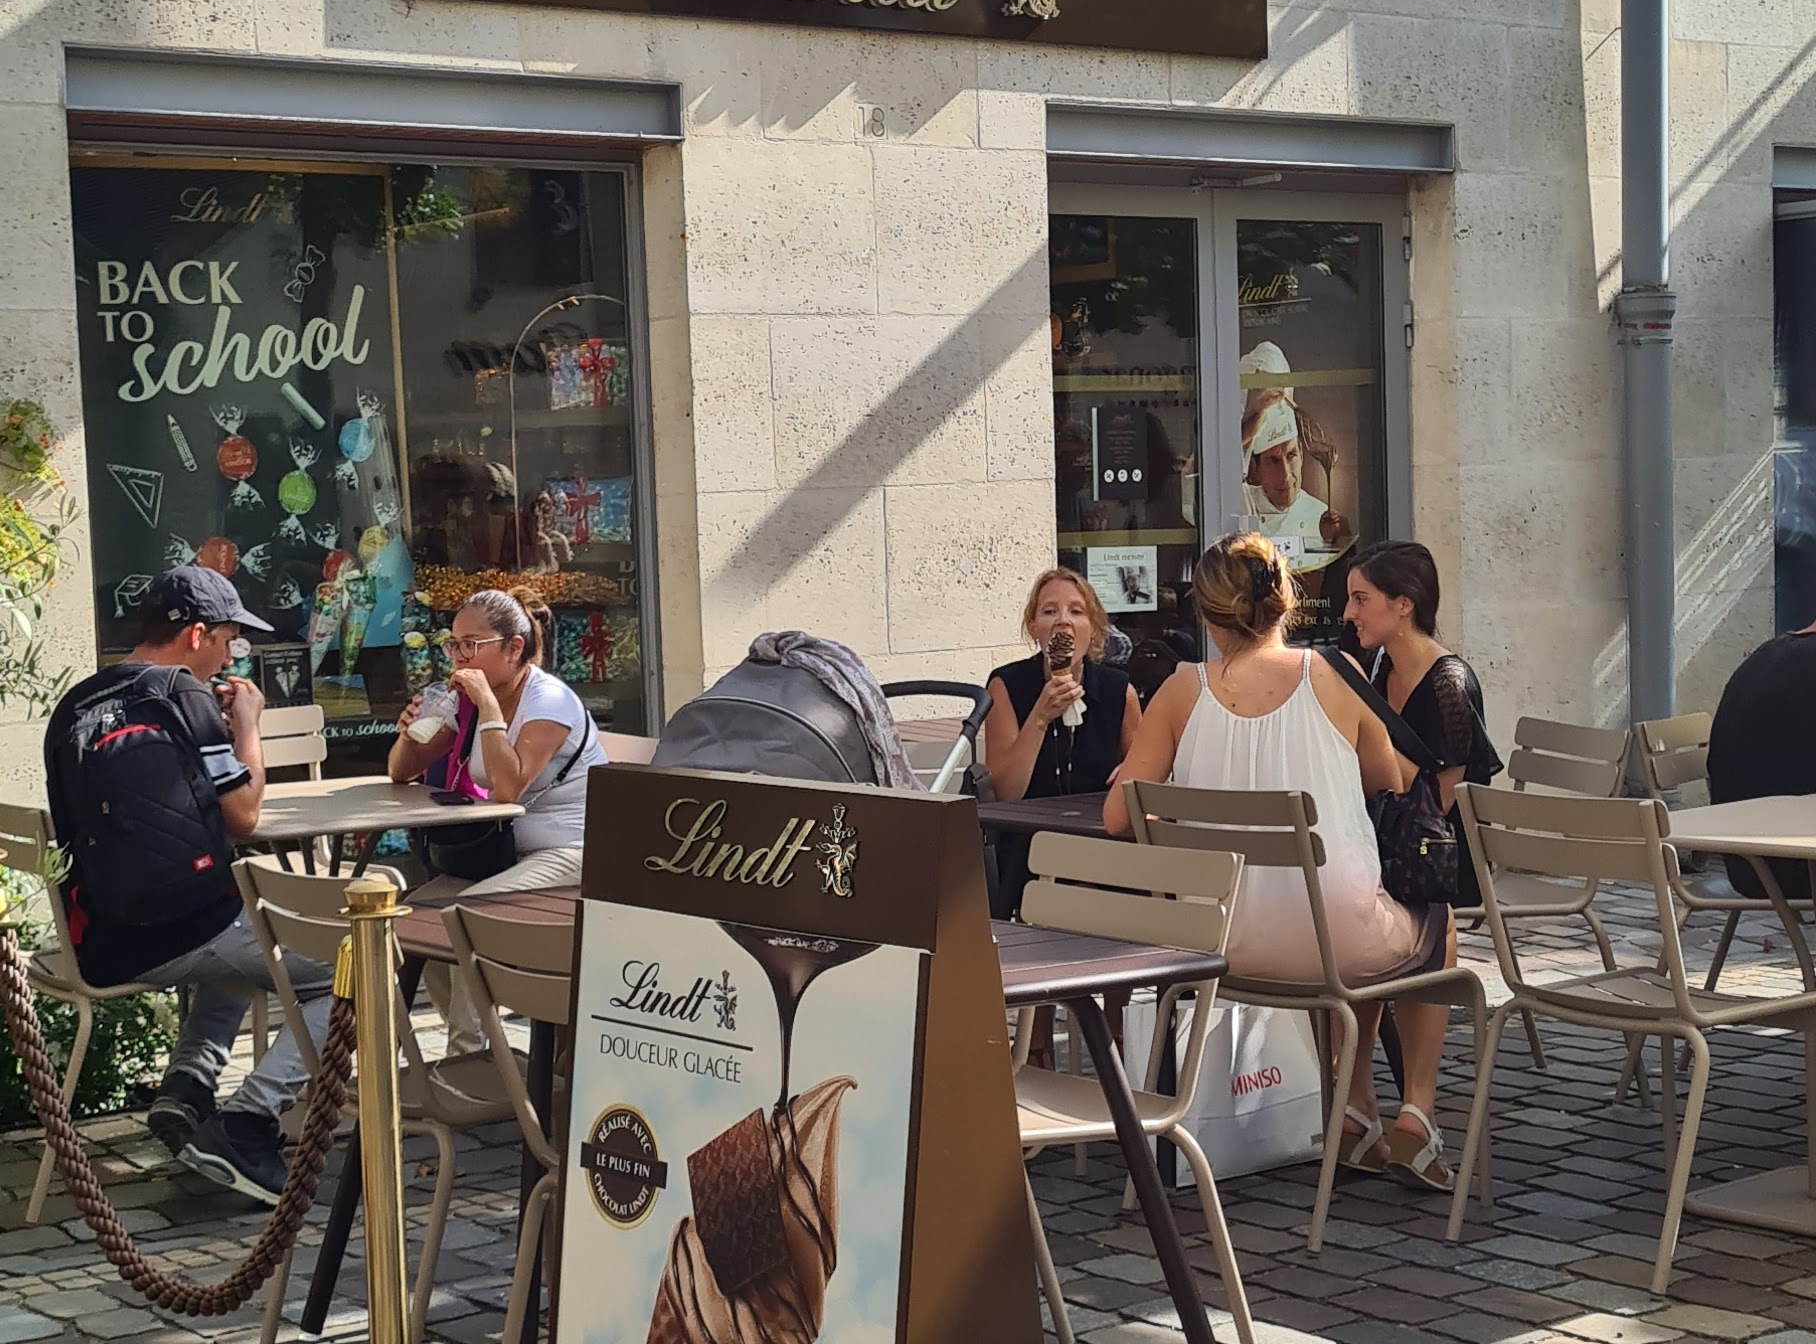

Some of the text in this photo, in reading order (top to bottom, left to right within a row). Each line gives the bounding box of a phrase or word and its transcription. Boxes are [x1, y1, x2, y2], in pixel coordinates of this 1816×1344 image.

[858, 106, 885, 137] 18
[97, 260, 243, 305] BACK
[97, 310, 154, 342] TO
[118, 284, 370, 402] school
[643, 797, 816, 888] Lindt
[609, 960, 713, 1023] Lindt
[600, 1033, 742, 1084] DOUCEUR GLACÉE
[1231, 1066, 1282, 1098] MINISO
[631, 1122, 652, 1155] AVEC
[596, 1152, 651, 1179] LE PLUS FIN
[594, 1173, 650, 1216] CHOCOLAT LINDT
